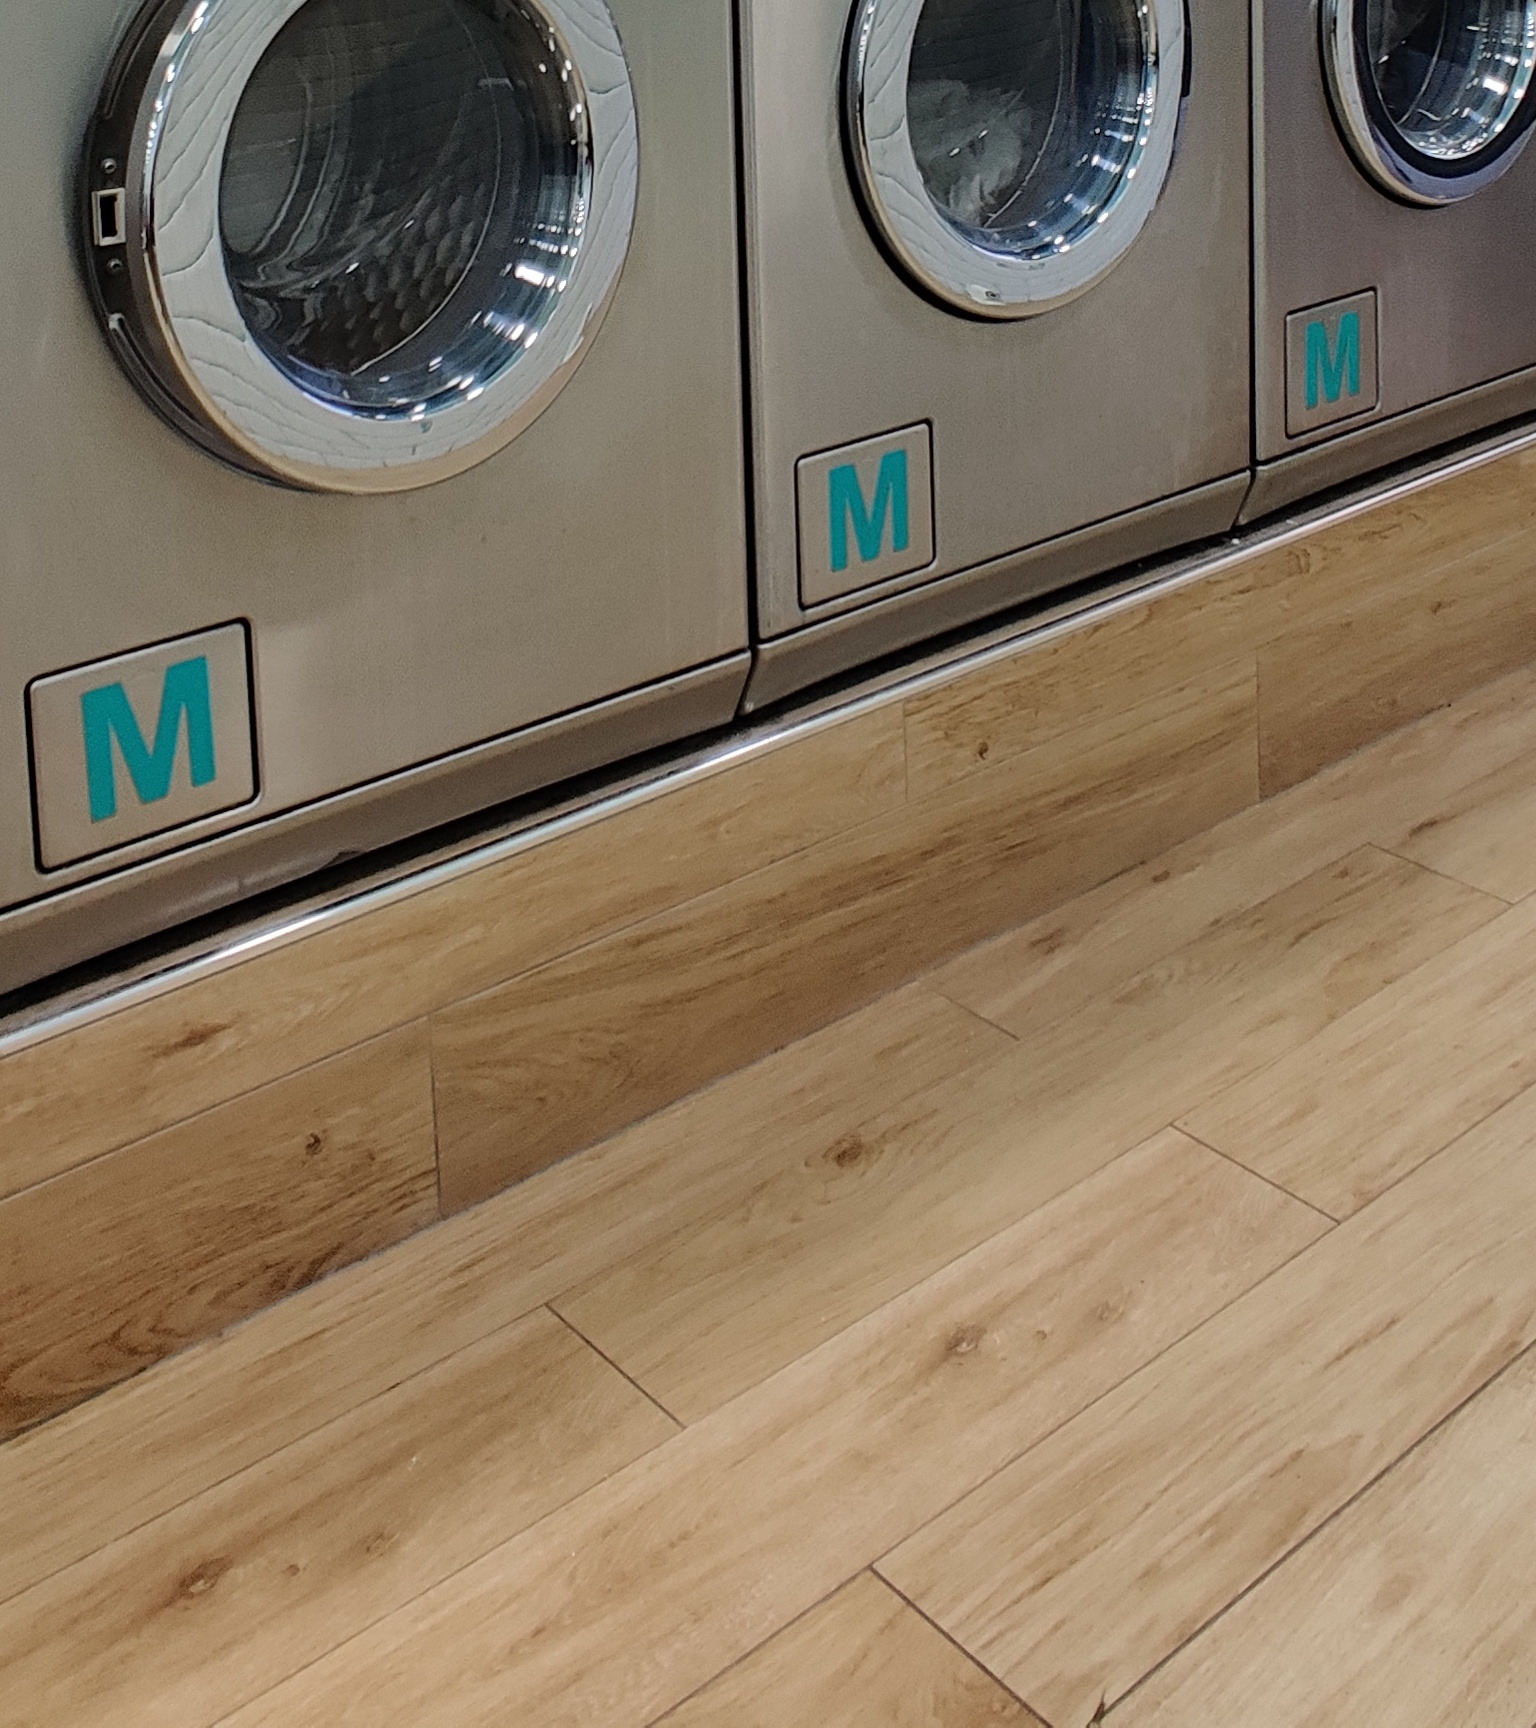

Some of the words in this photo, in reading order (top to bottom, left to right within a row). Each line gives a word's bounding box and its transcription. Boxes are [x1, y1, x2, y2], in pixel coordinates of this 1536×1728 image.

[1305, 310, 1361, 411] M
[827, 448, 909, 573] M
[81, 655, 217, 824] M
